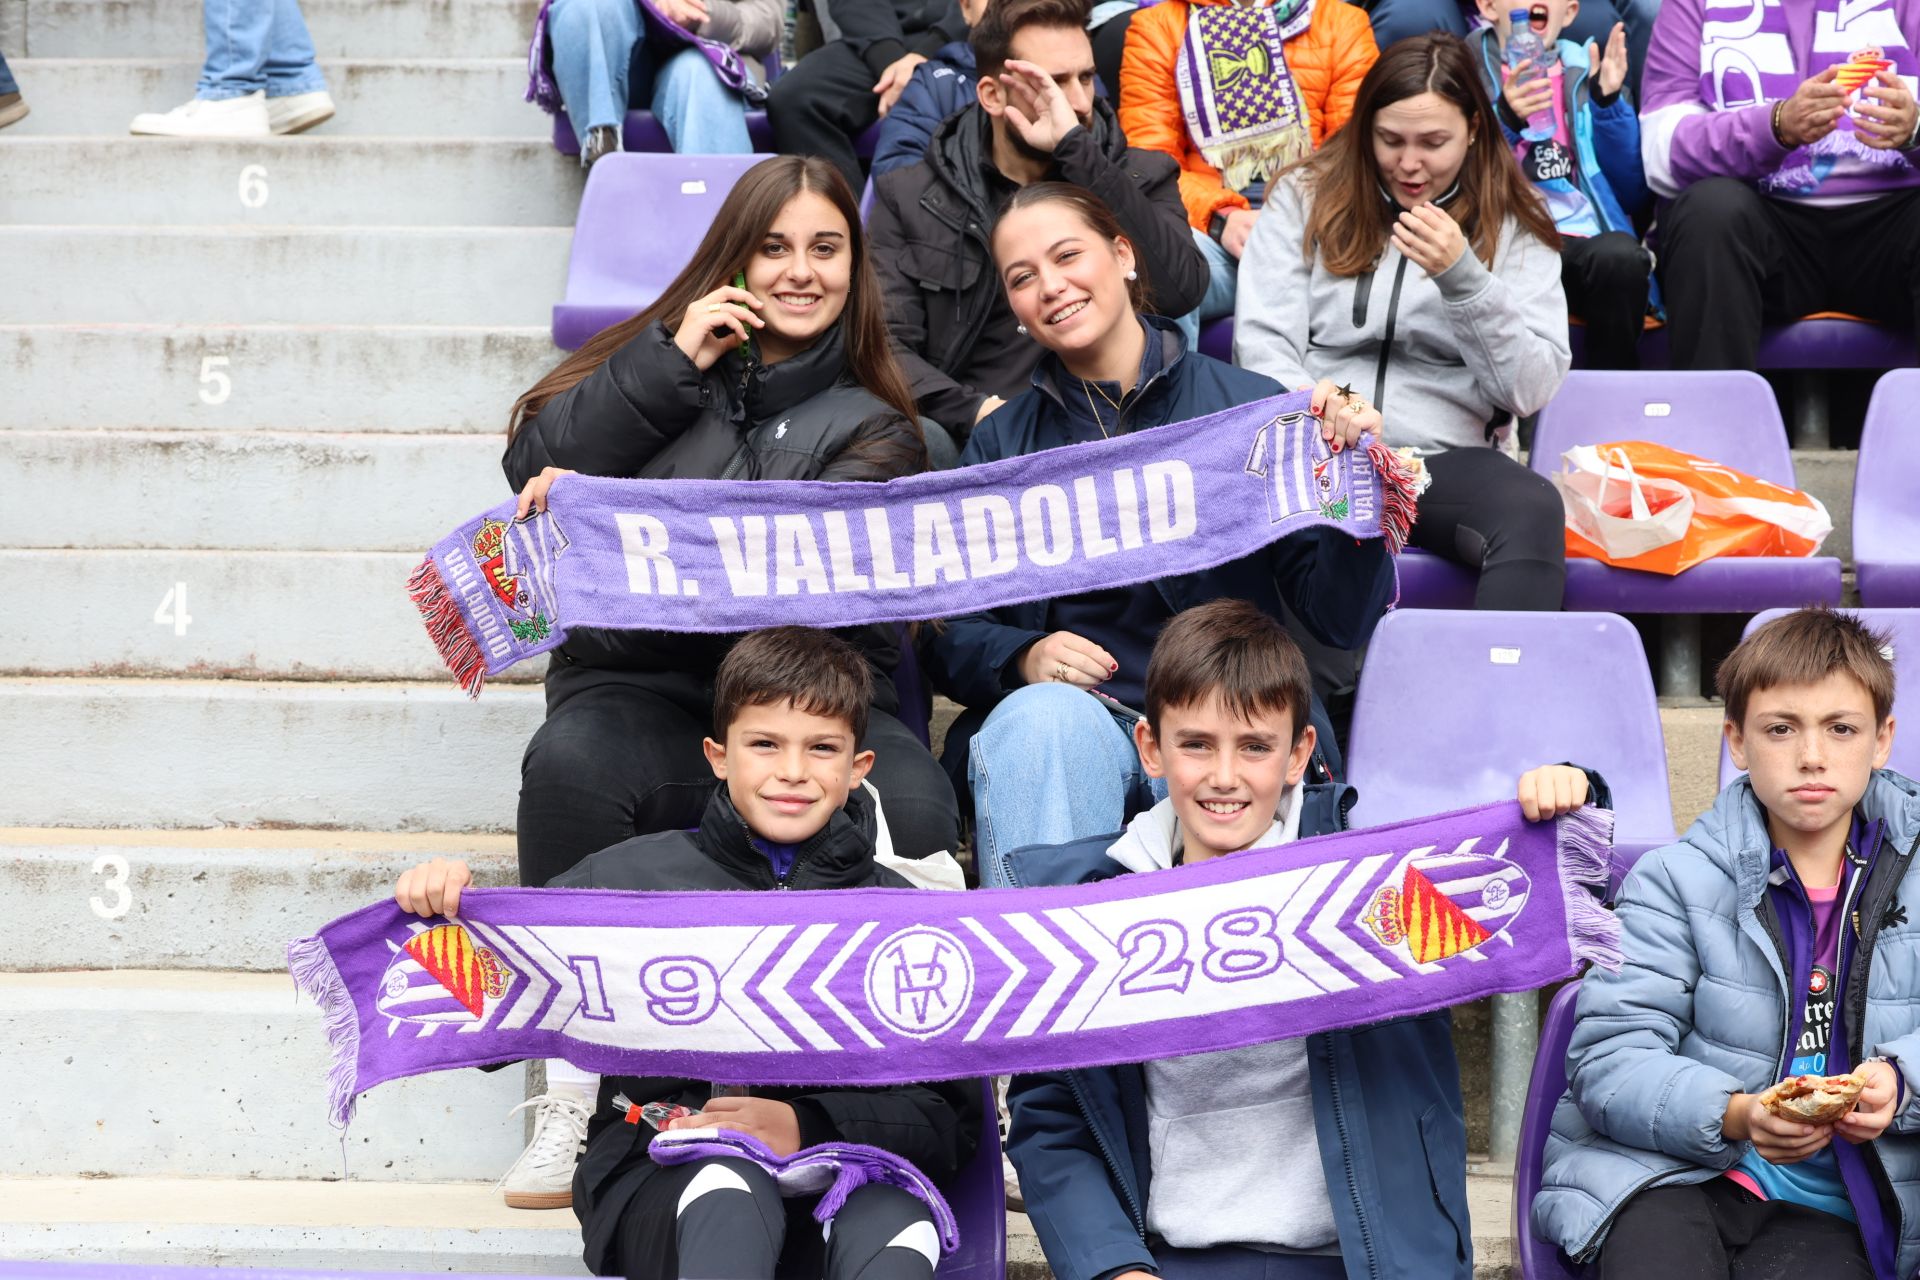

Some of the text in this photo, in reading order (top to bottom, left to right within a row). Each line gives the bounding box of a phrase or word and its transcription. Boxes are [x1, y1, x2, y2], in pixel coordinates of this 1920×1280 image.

[1269, 38, 1282, 54] LA
[1272, 56, 1287, 75] DE
[1278, 79, 1297, 115] COPA
[238, 164, 269, 208] 6
[198, 356, 231, 405] 5
[614, 459, 1197, 597] R. VALLADOLID
[154, 577, 192, 636] 4
[444, 547, 512, 659] VALLADOLID
[90, 855, 132, 918] 3
